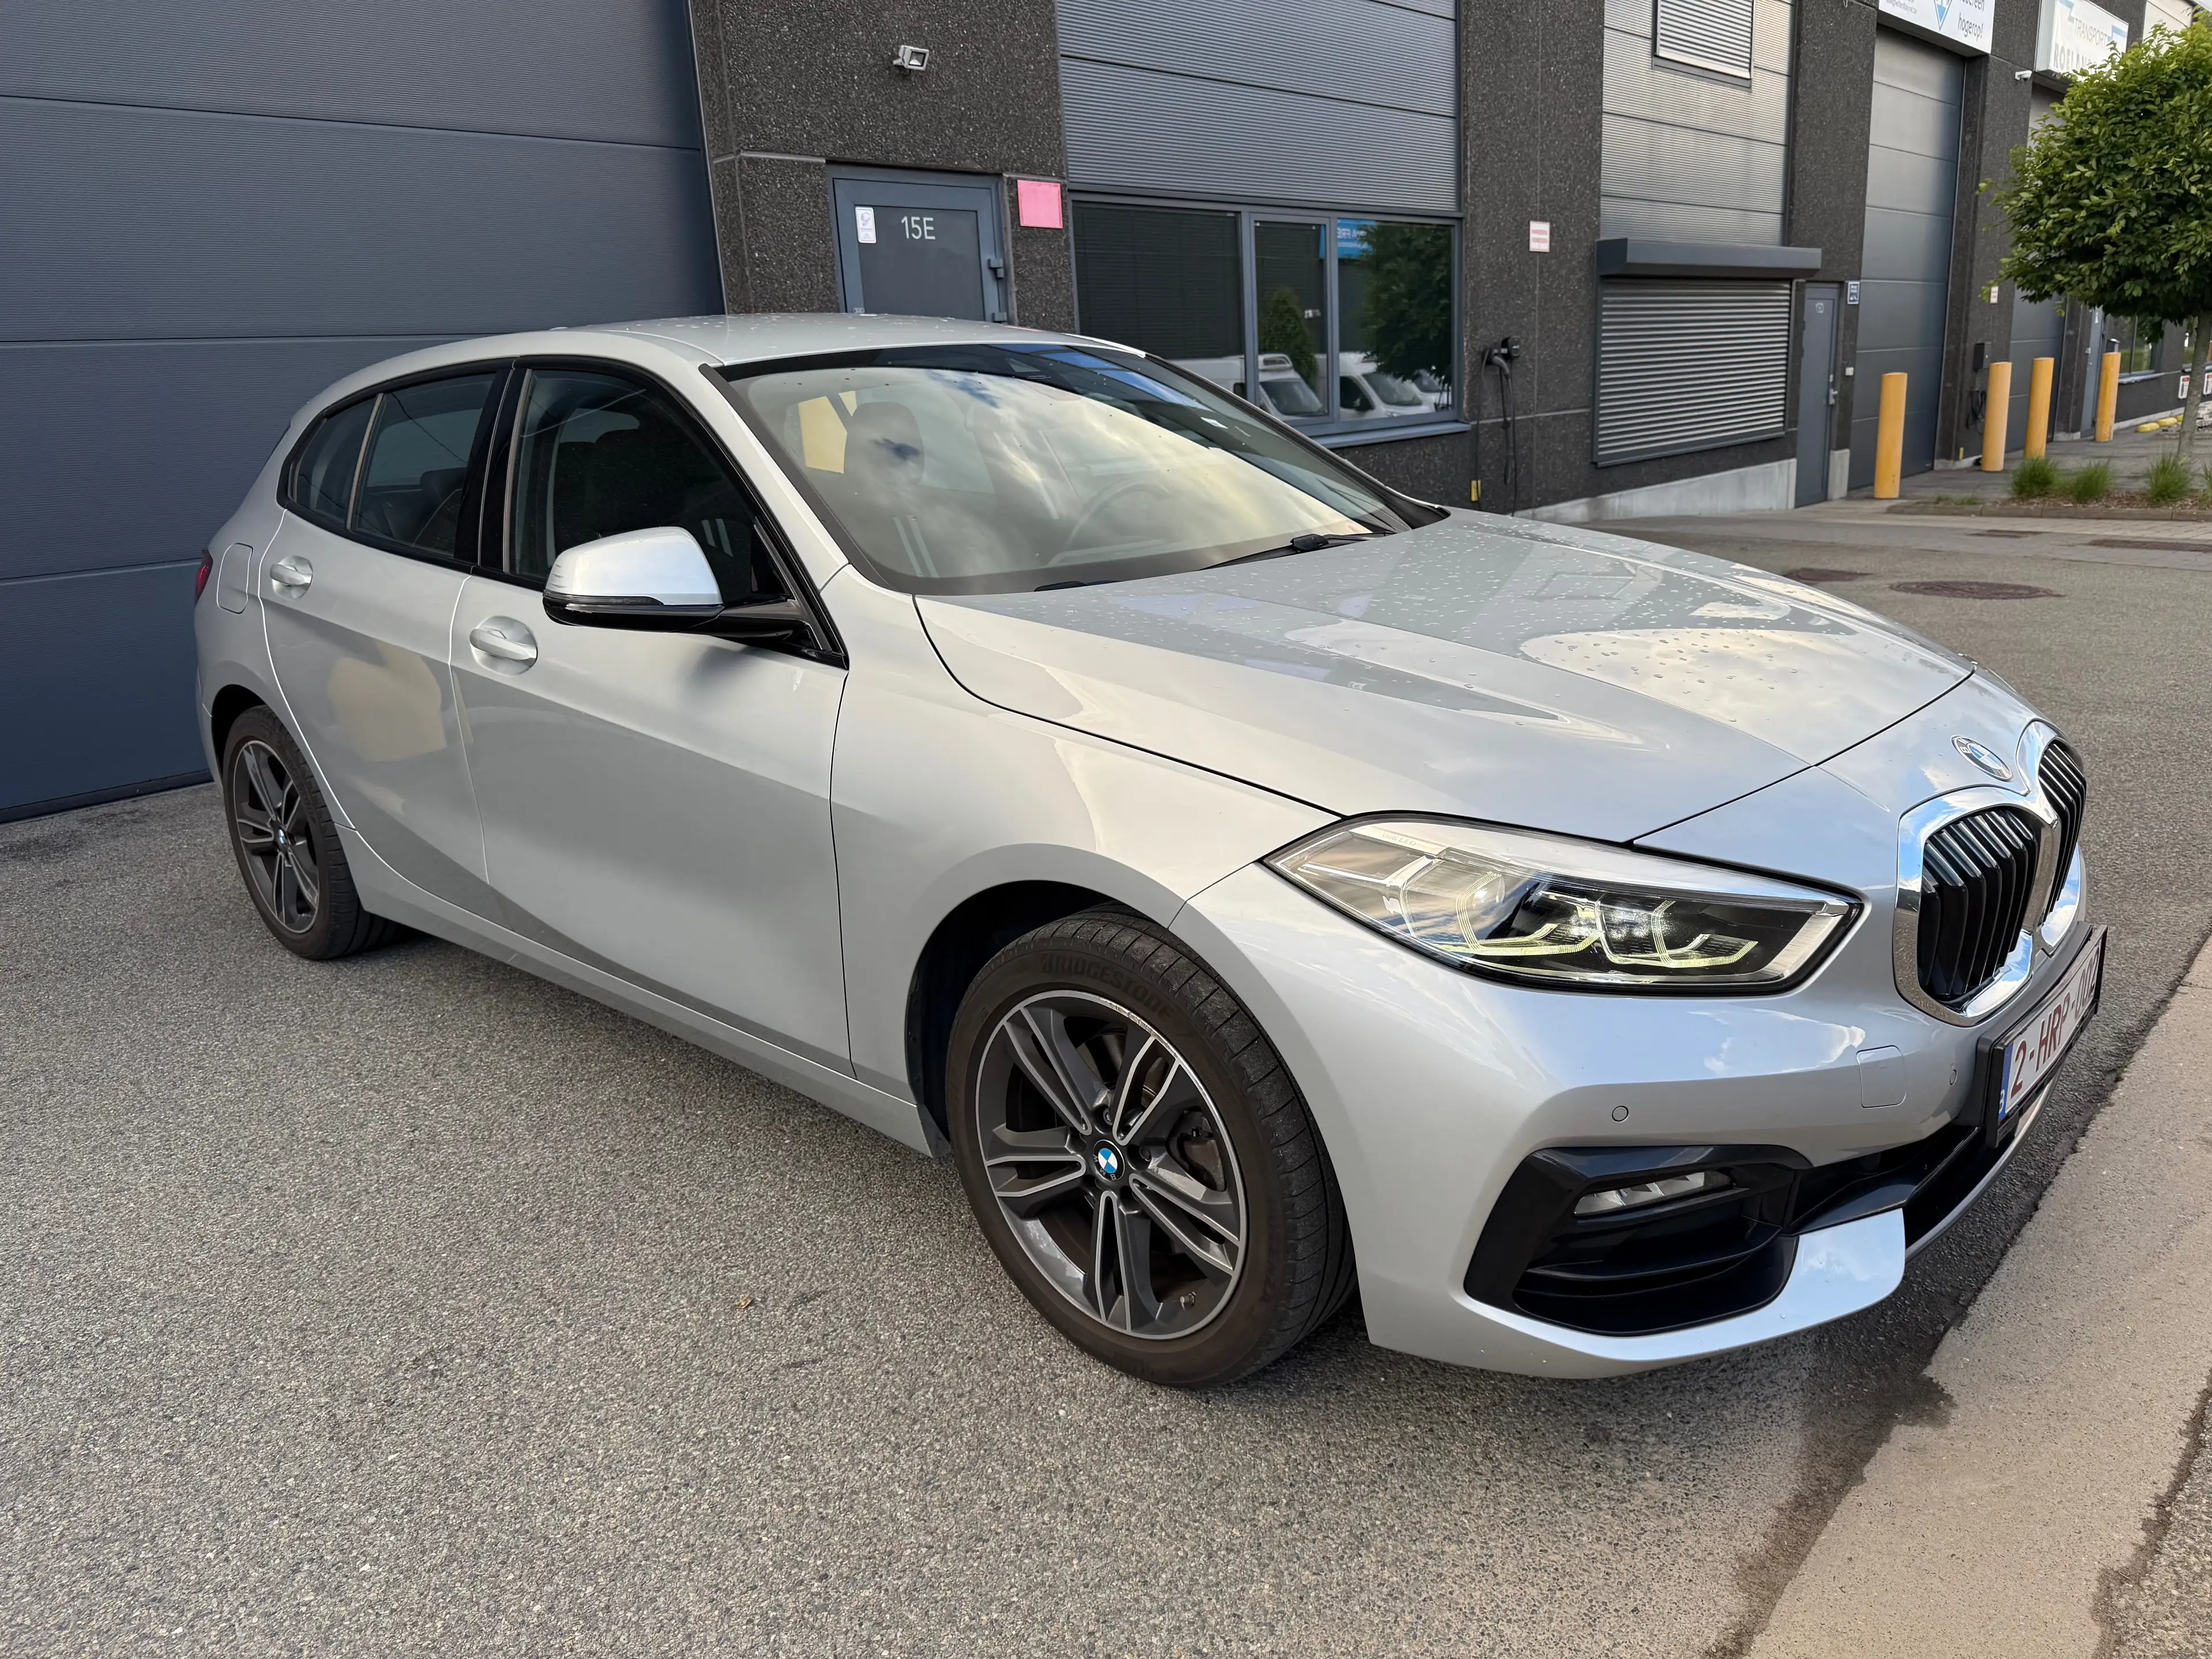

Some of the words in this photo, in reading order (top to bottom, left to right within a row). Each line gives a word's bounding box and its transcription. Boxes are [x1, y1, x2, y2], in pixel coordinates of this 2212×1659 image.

[1958, 13, 1983, 41] hogerop!
[2074, 18, 2108, 48] TRANSPORT
[2054, 43, 2097, 71] ROELAN
[901, 215, 936, 240] 15E
[1399, 838, 1416, 846] LED
[1040, 953, 1176, 1020] BRIDGESTONE
[2010, 945, 2100, 1099] 2-HRP-002
[1999, 1089, 2005, 1113] B
